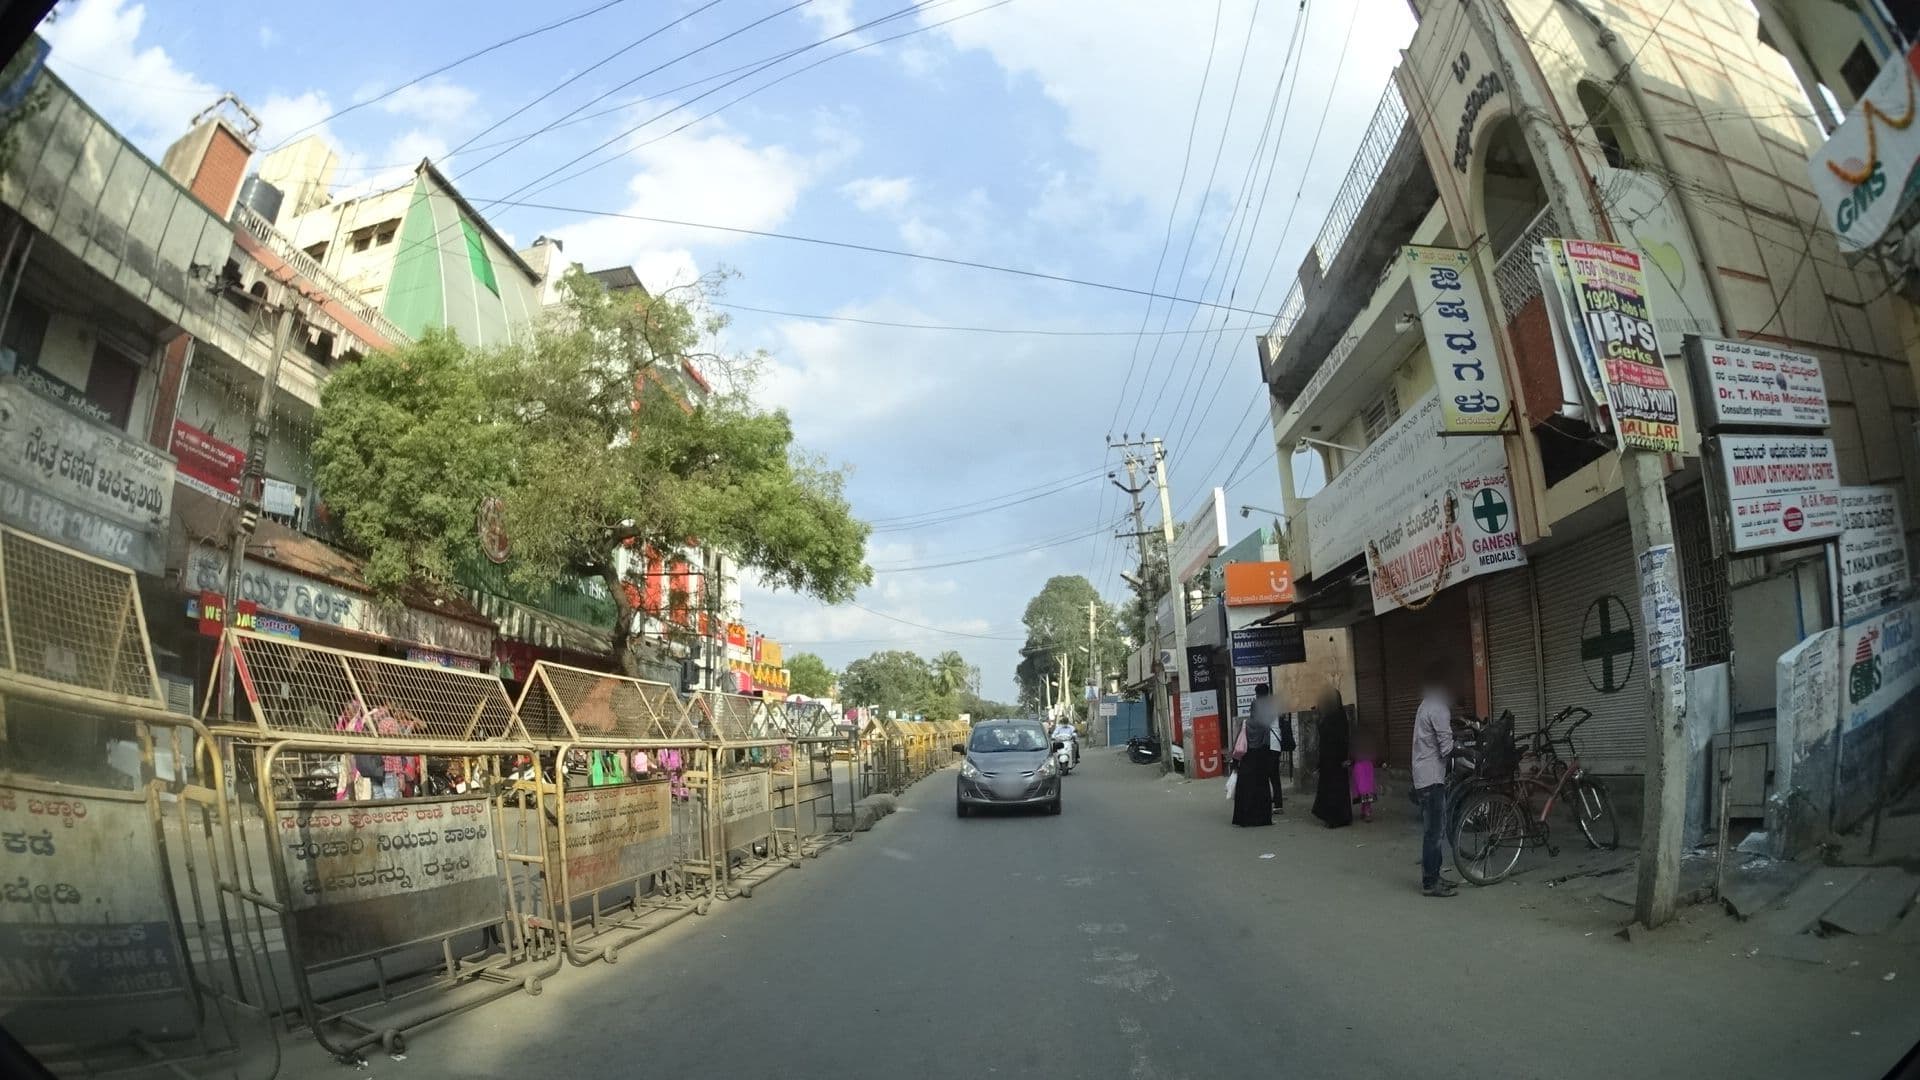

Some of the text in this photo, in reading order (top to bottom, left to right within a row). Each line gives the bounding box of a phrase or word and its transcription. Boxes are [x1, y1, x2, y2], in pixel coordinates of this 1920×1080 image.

[1719, 387, 1735, 400] Dr.
[1738, 389, 1748, 400] T.
[1750, 389, 1780, 405] Khaja
[1733, 465, 1766, 486] MUKUND
[1811, 462, 1835, 480] CENTRE
[1472, 533, 1519, 553] GANESH
[1479, 550, 1516, 566] MEDICALS
[204, 605, 257, 629] WEOME
[1238, 675, 1268, 684] Lenovo
[376, 831, 438, 851] ನಿಯಮ
